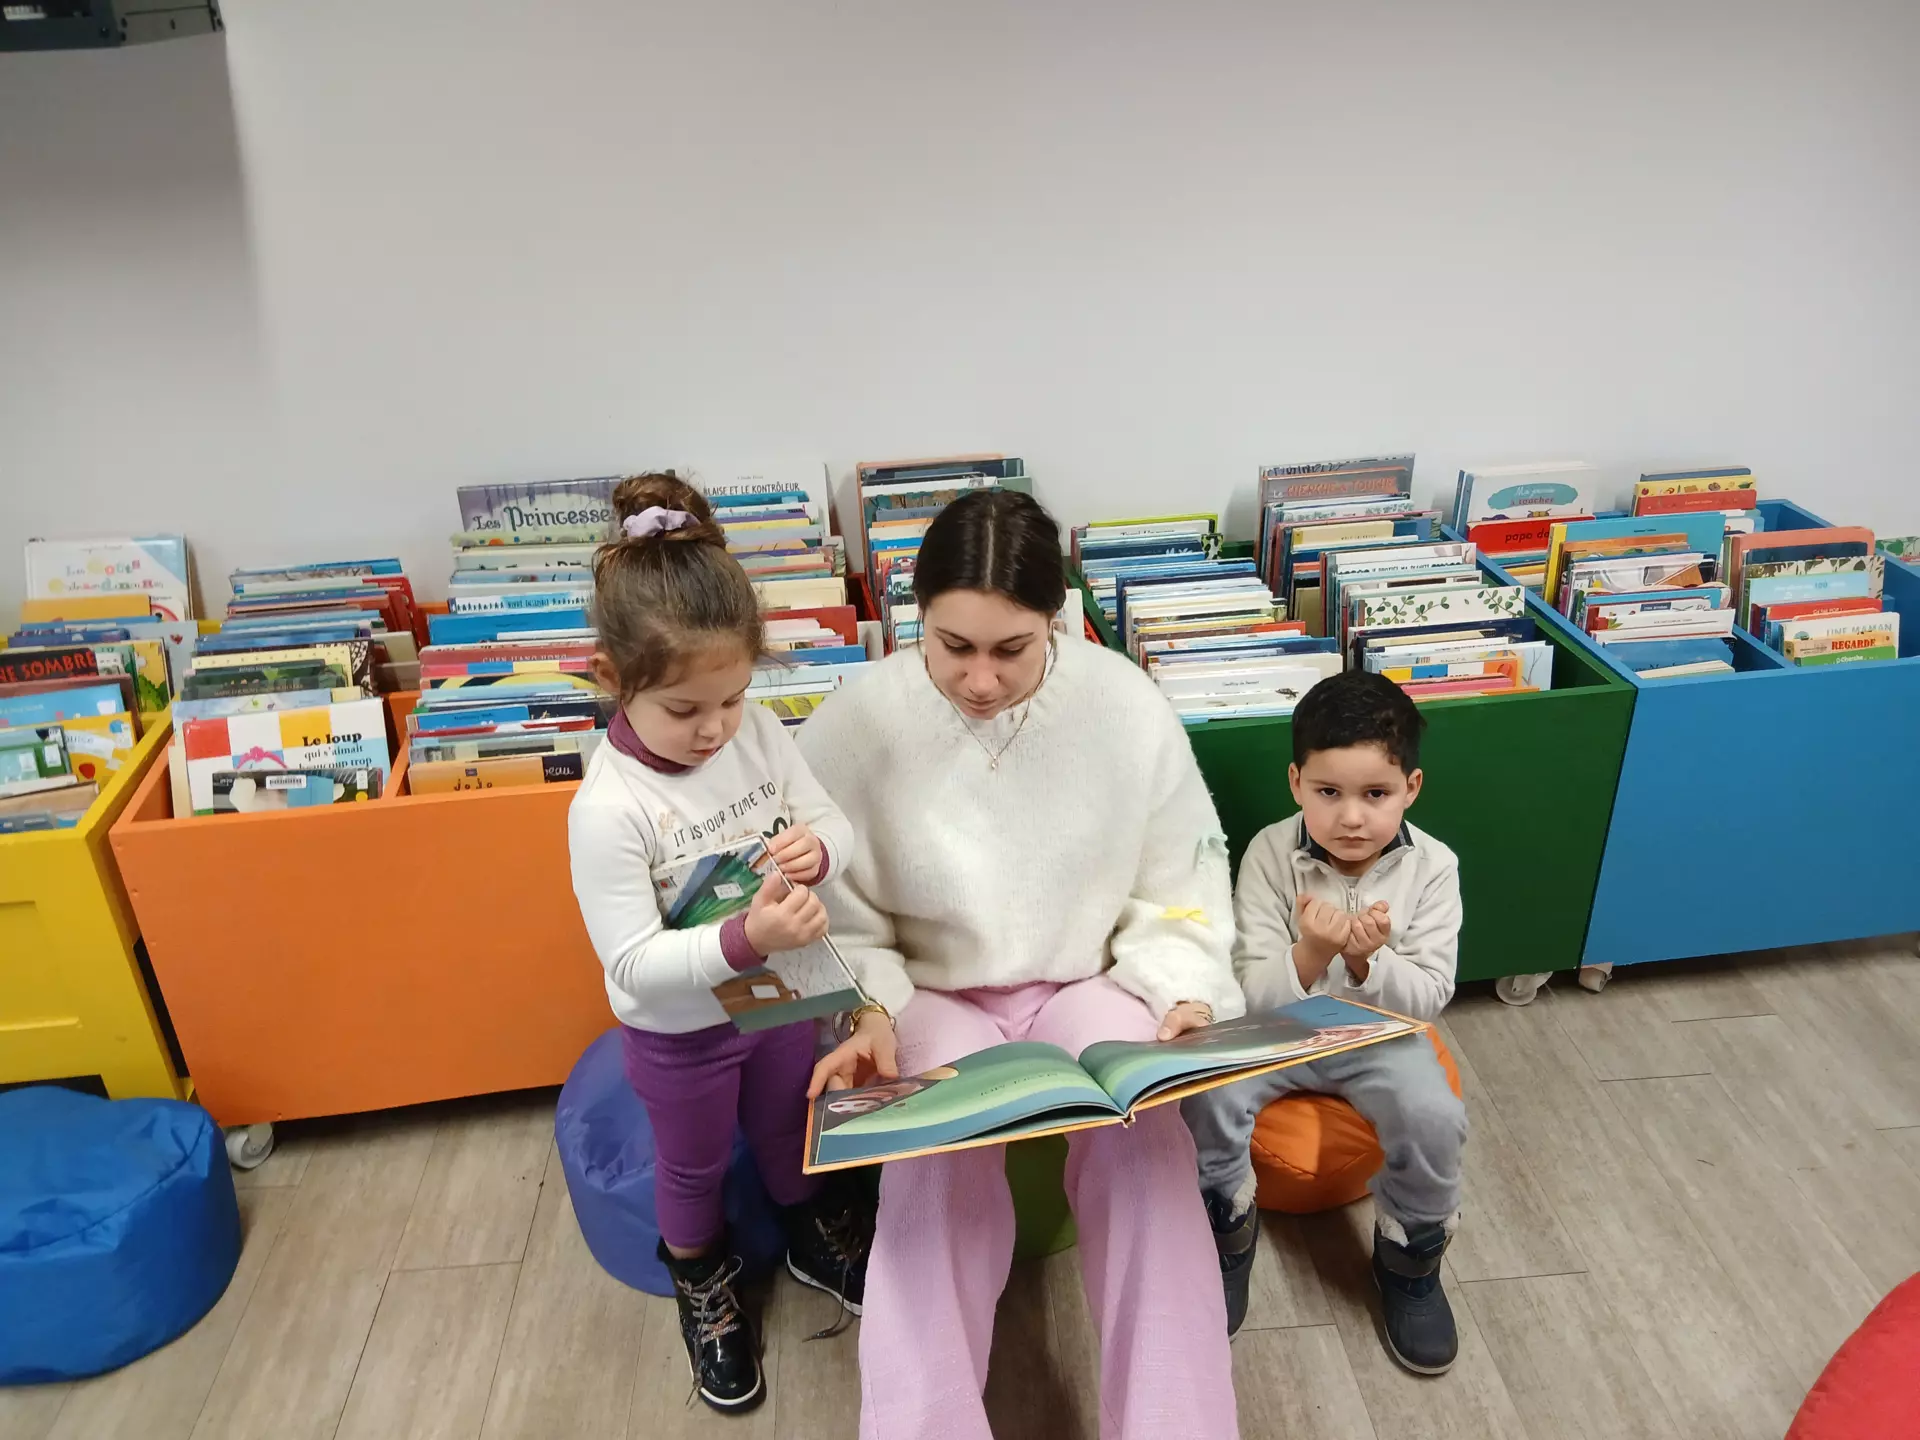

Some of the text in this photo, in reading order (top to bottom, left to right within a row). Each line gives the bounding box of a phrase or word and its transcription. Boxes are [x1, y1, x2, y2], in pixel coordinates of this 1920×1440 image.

[729, 485, 739, 496] ET
[741, 484, 750, 495] LE
[752, 480, 800, 494] KONTRÔLEUR
[472, 515, 501, 531] Les
[1851, 623, 1893, 634] MAMAN
[1831, 638, 1876, 651] REGARDE
[21, 650, 97, 681] SOMBRE
[302, 731, 363, 747] Le loup
[304, 744, 364, 762] qui s'aimait
[350, 756, 373, 769] trop
[673, 781, 777, 848] IT IS YOUR TIME TO
